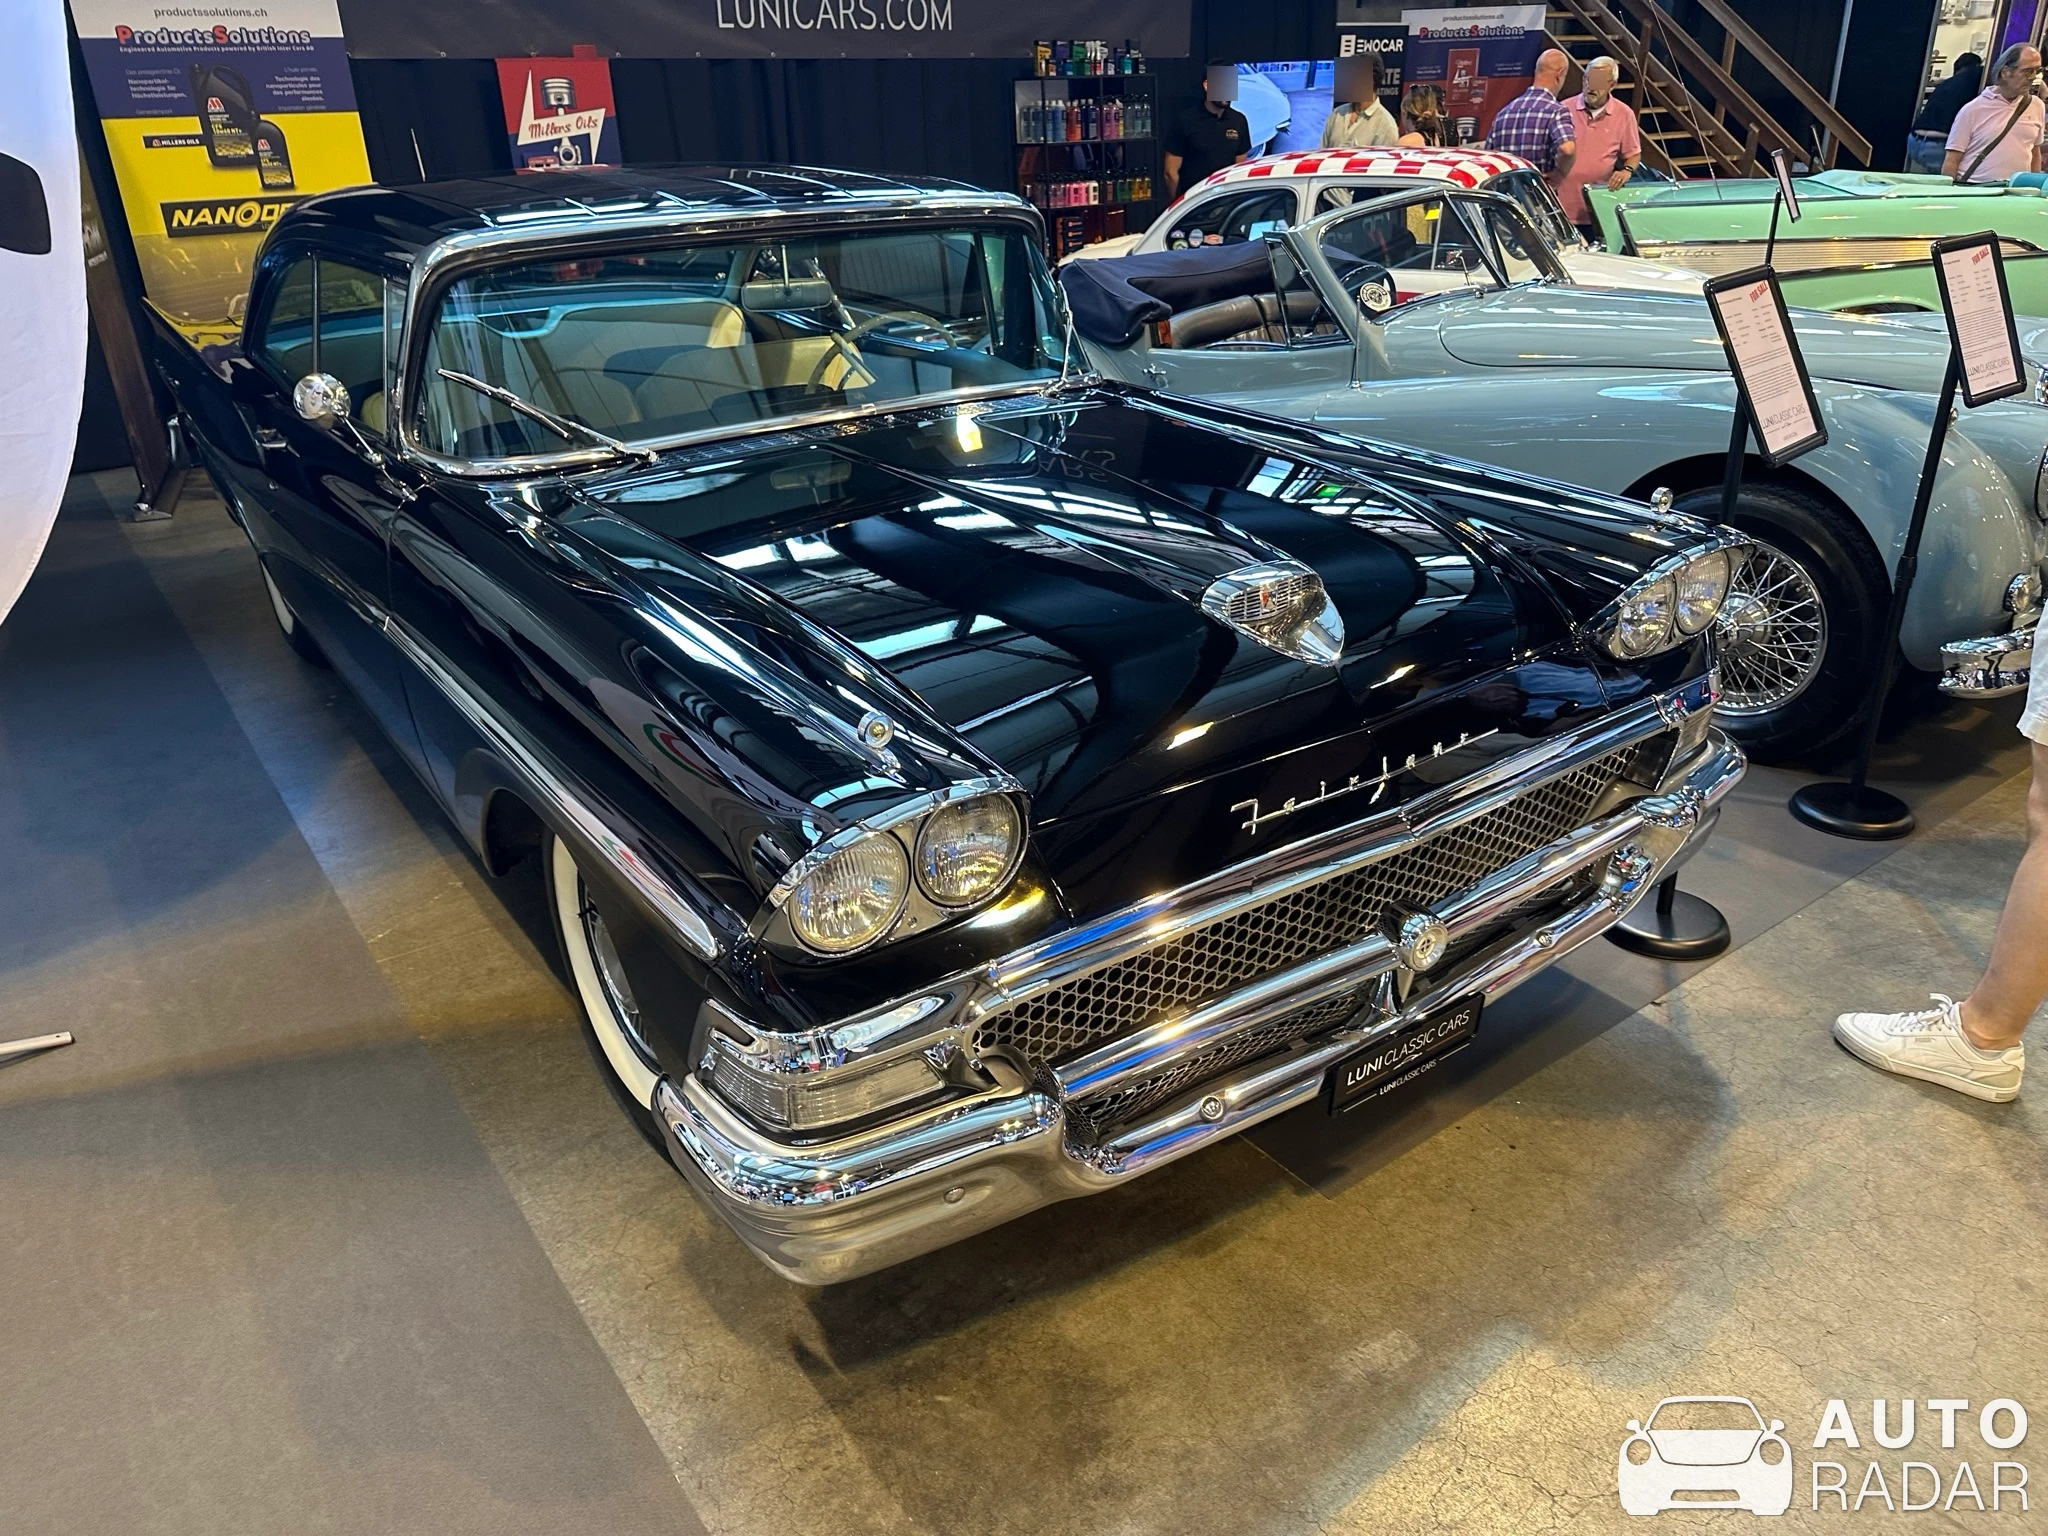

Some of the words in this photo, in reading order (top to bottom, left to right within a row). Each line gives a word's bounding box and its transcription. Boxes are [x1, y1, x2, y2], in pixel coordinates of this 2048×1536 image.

[153, 7, 268, 18] productssolutions.ch
[716, 0, 953, 30] LUNICARS.COM
[114, 25, 311, 44] ProductsSolutions
[1419, 25, 1525, 38] ProductsSolutions
[1356, 39, 1404, 53] EWOCAR
[528, 122, 572, 139] Millers
[575, 115, 599, 129] Oils
[1346, 1055, 1383, 1086] LUNI
[1383, 1028, 1436, 1066] CLASSIC
[1437, 1009, 1471, 1037] CARS
[1420, 1059, 1437, 1073] CARS
